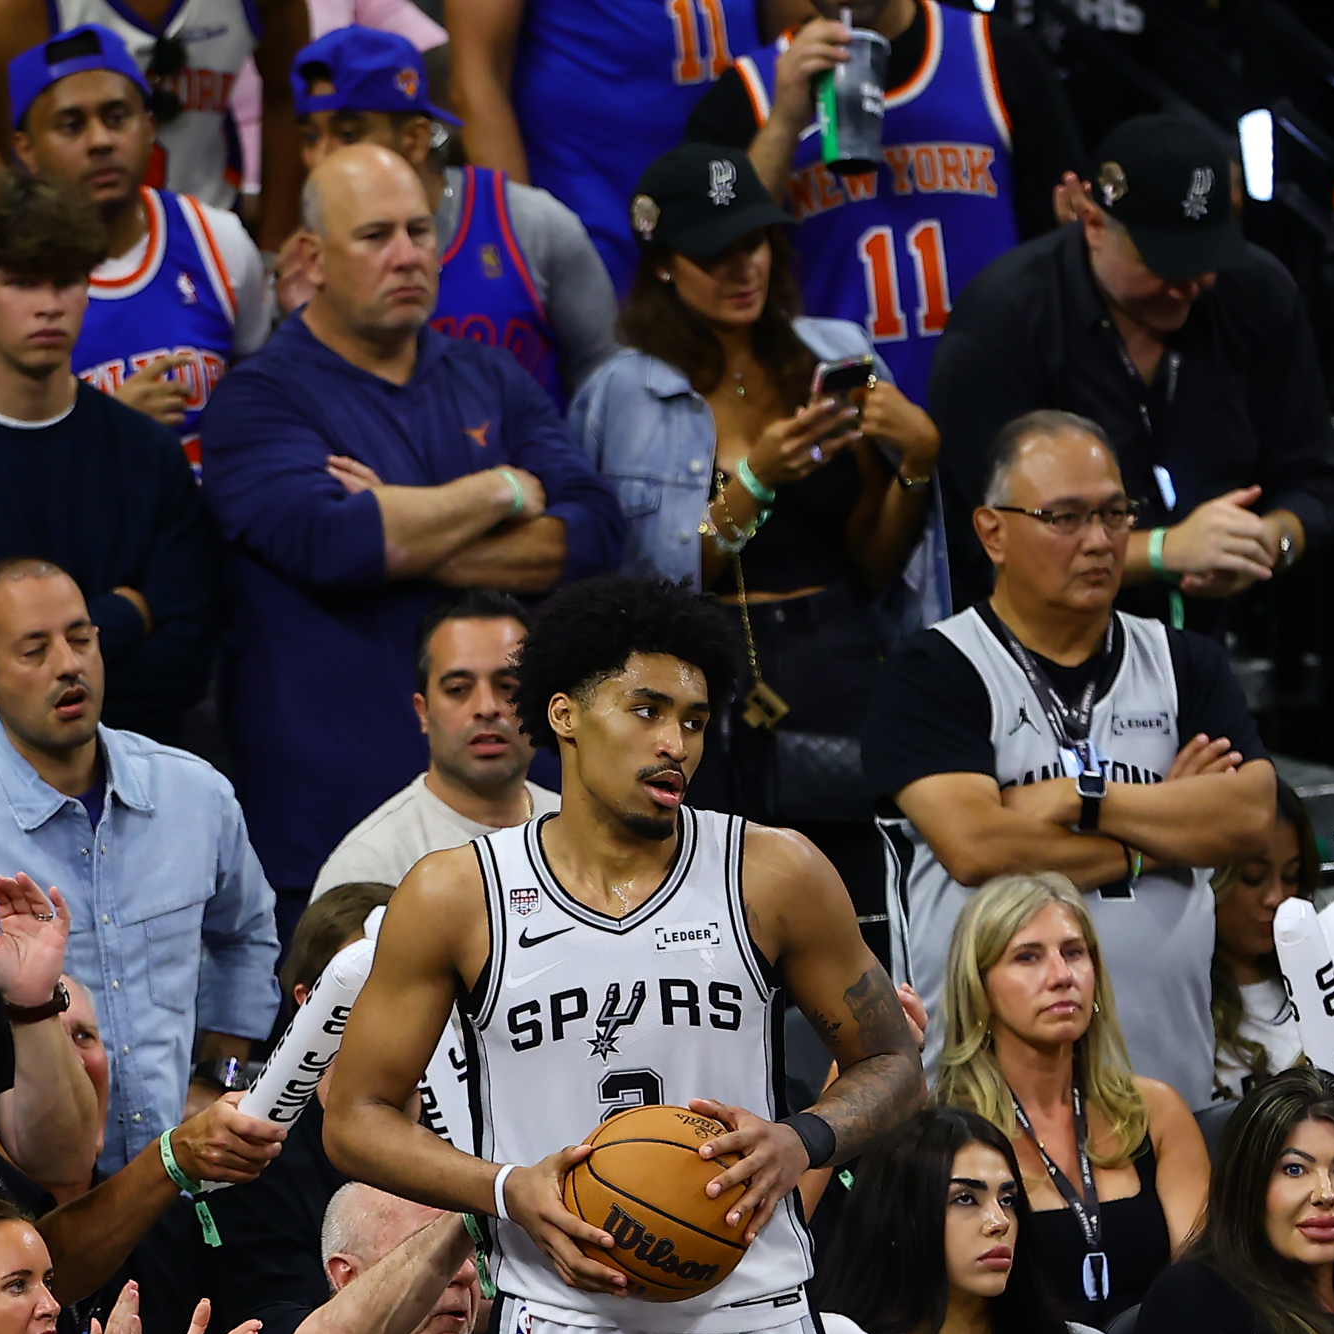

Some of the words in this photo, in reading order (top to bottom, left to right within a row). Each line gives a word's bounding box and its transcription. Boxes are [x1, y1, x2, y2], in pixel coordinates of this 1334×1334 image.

[882, 143, 999, 198] YORK
[856, 218, 954, 343] 11
[1120, 718, 1163, 730] LEDGER
[510, 901, 538, 911] 250
[511, 890, 537, 899] USA
[663, 929, 711, 943] LEDGER
[506, 976, 744, 1066] SPURS
[603, 1202, 719, 1282] Wilson
